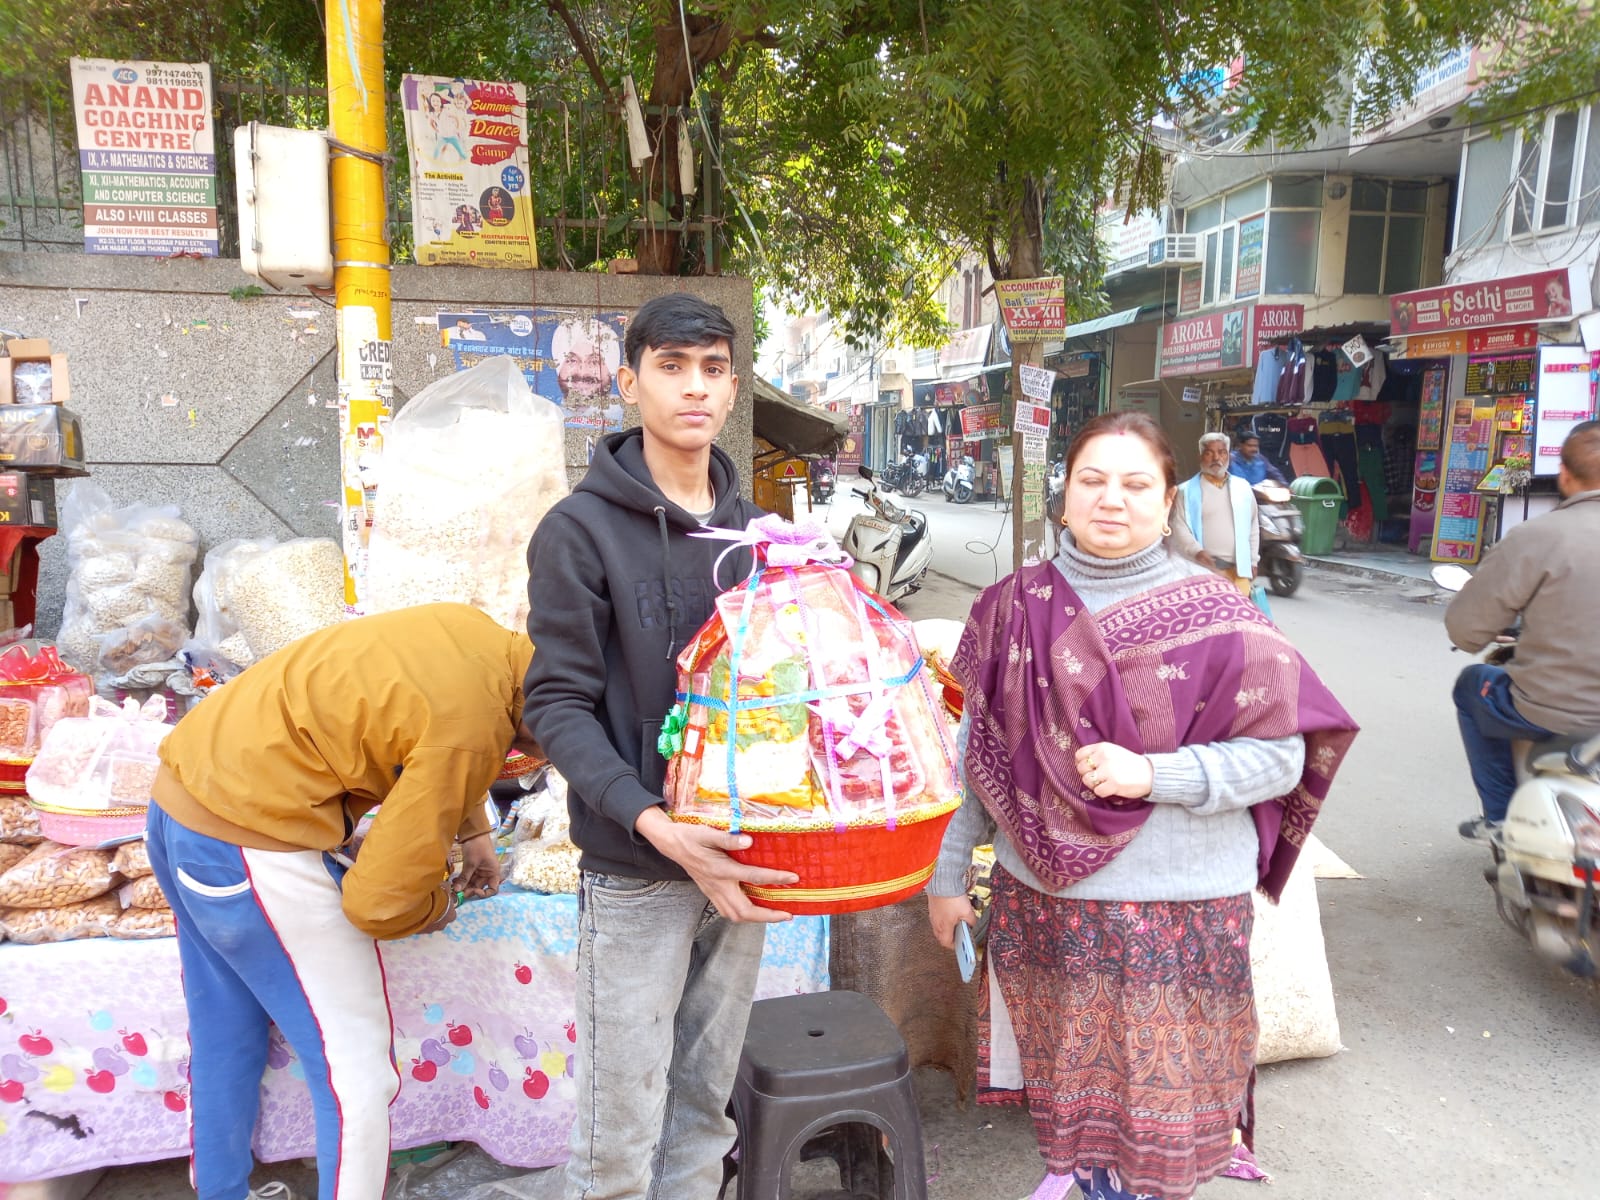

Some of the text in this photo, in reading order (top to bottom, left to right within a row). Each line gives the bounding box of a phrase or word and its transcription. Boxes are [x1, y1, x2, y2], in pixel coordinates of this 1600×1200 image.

[1438, 57, 1469, 82] WORKS
[146, 77, 204, 88] 9811190551
[83, 83, 204, 111] ANAND
[479, 82, 516, 99] KIDS
[84, 109, 205, 132] COACHING
[473, 120, 521, 137] Dance
[94, 130, 191, 150] CENTRE
[476, 146, 508, 159] Camp
[109, 152, 166, 169] MATHEMATICS
[167, 156, 174, 168] &
[175, 156, 209, 171] SCIENCE
[169, 178, 210, 190] ACCOUNTS
[507, 182, 519, 190] yrs
[94, 190, 207, 204] AND COMPUTER SCIENCE
[95, 209, 208, 224] ALSO I-VIII CLASSES
[96, 227, 115, 235] JOIN
[134, 228, 150, 236] FOR
[172, 230, 205, 238] RESULTS
[1001, 279, 1062, 292] ACCOUNTANCY
[1452, 286, 1503, 314] Sethi
[1505, 287, 1532, 299] SUNDAE
[1419, 301, 1436, 310] JUICE
[1513, 302, 1532, 312] MORE
[1011, 306, 1061, 320] XI, XII
[1260, 309, 1297, 327] ARORA
[1462, 312, 1495, 326] Cream
[1170, 319, 1214, 345] ARORA
[1487, 332, 1515, 344] zomato
[1189, 338, 1221, 352] PROPERTIES
[0, 410, 36, 424] NIC
